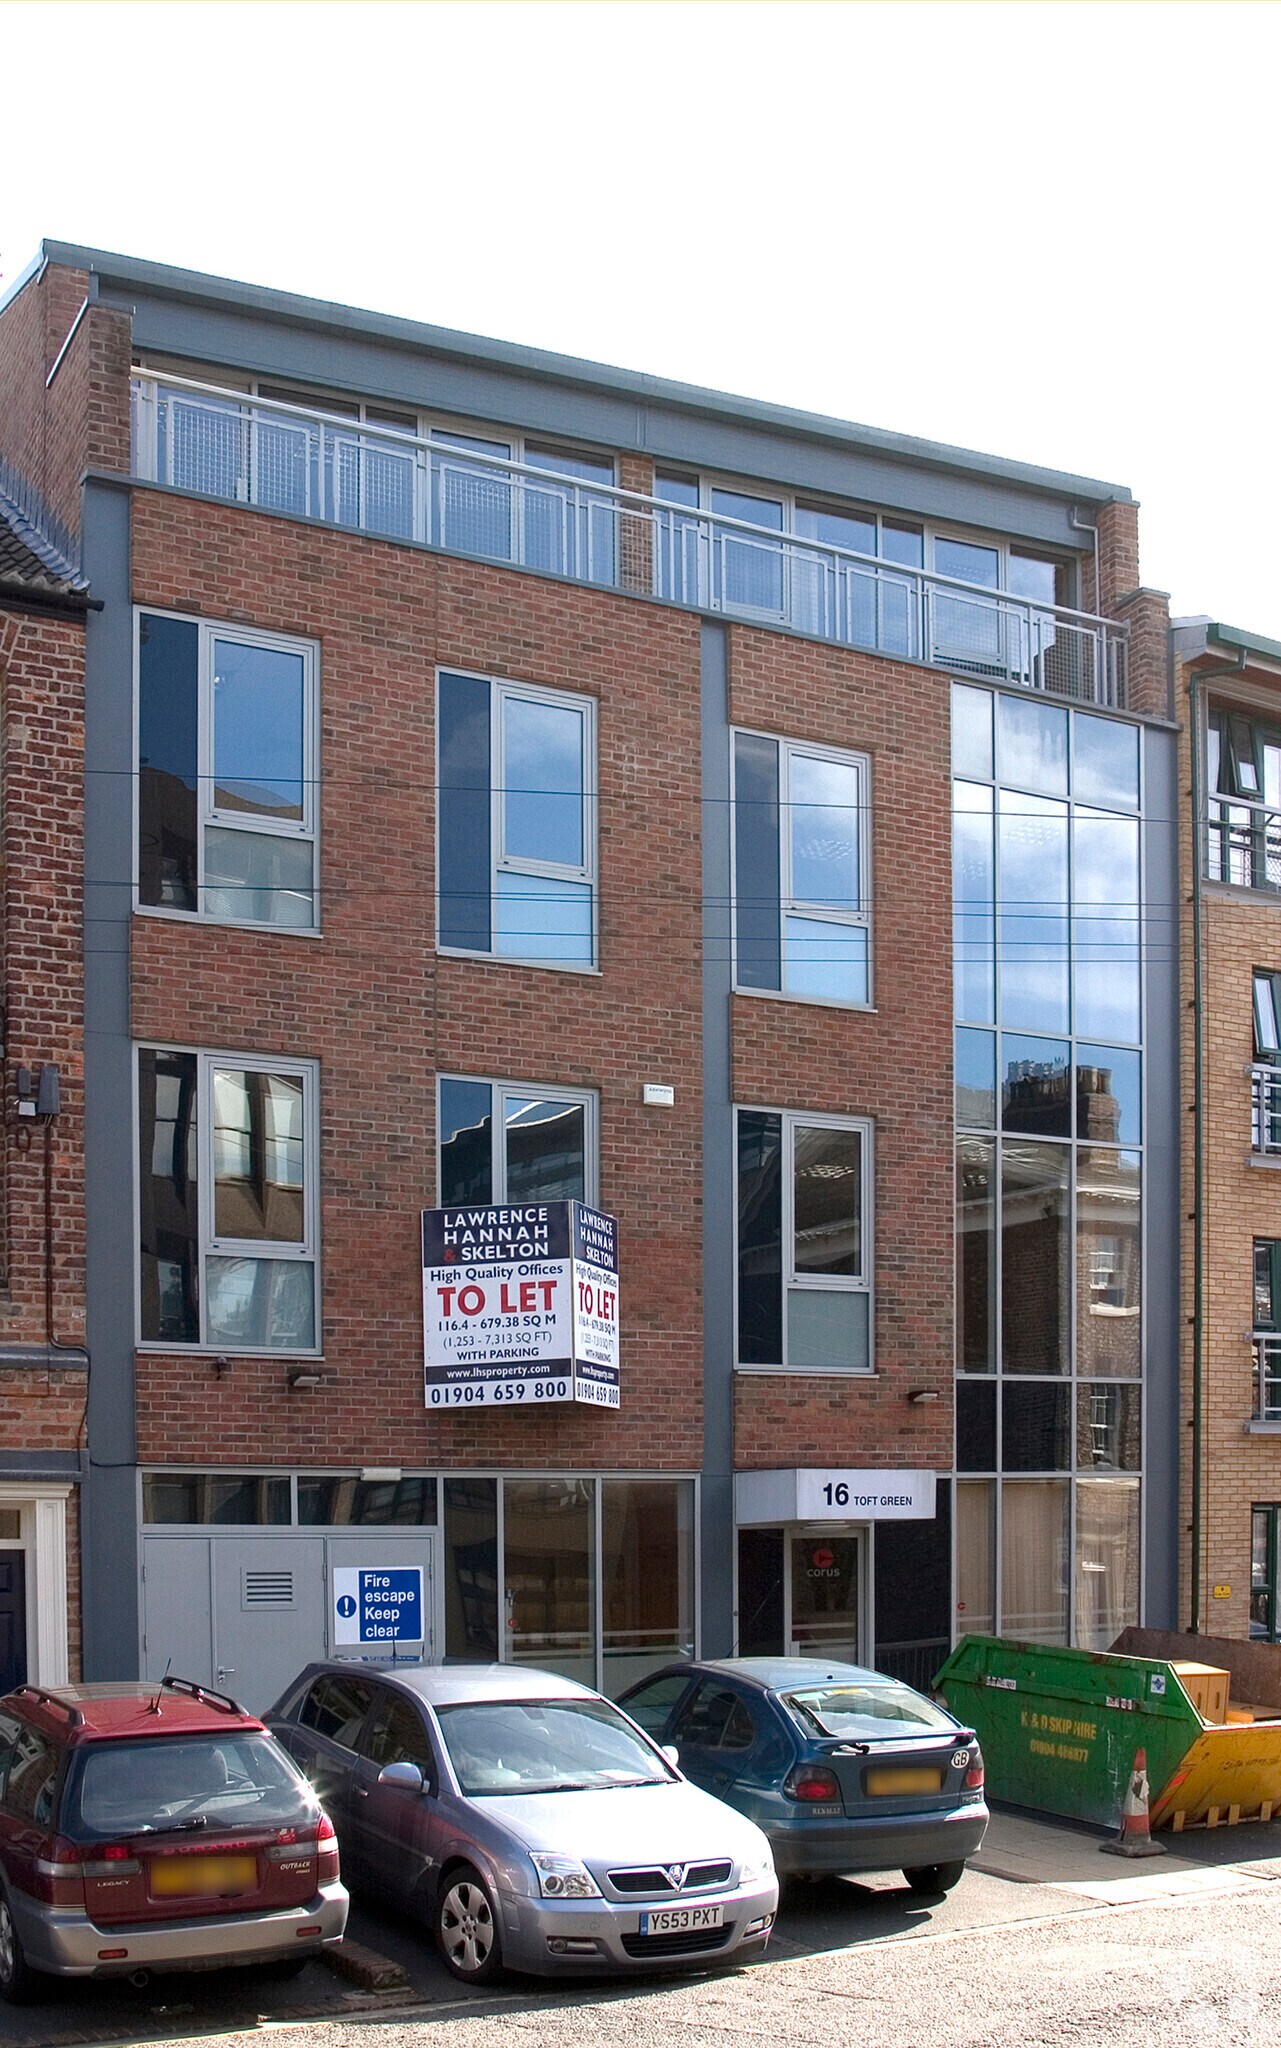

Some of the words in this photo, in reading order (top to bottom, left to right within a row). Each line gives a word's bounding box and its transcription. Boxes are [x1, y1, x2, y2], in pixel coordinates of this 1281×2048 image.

[444, 1208, 548, 1228] LAWRENCE
[580, 1208, 613, 1236] LAWRENCE
[444, 1225, 548, 1245] HANNAH
[580, 1226, 613, 1252] HANNAH
[444, 1249, 456, 1262] &
[461, 1242, 549, 1261] SKELTON
[586, 1245, 614, 1268] SKELTON
[430, 1269, 461, 1284] High
[465, 1266, 514, 1280] Quality
[518, 1264, 563, 1276] Offices
[437, 1285, 486, 1317] TO
[500, 1280, 557, 1313] LET
[579, 1281, 593, 1315] TO
[597, 1288, 616, 1321] LET
[438, 1320, 469, 1332] 116.4
[480, 1316, 519, 1329] 679.38
[523, 1315, 541, 1327] SQ
[545, 1314, 556, 1325] M
[443, 1336, 475, 1349] (1,253
[485, 1333, 513, 1346] 7,313
[515, 1332, 532, 1343] SQ
[534, 1331, 553, 1344] FT)
[457, 1350, 487, 1361] WITH
[490, 1347, 540, 1359] PARKING
[446, 1365, 550, 1379] www.lhsproperty.com
[431, 1386, 485, 1404] 01904
[494, 1384, 526, 1400] 659
[534, 1381, 567, 1398] 800
[577, 1382, 594, 1400] 01904
[596, 1386, 607, 1402] 659
[823, 1482, 849, 1506] 16
[854, 1496, 878, 1506] TOFT
[880, 1496, 912, 1506] GREEN
[364, 1574, 390, 1588] Fire
[807, 1567, 840, 1578] corus
[365, 1591, 415, 1604] escape
[365, 1607, 400, 1622] Keep
[365, 1624, 400, 1637] clear
[1049, 1717, 1072, 1734] SKIP
[1073, 1721, 1097, 1740] HIRE
[954, 1751, 967, 1766] GB
[280, 1861, 311, 1870] OUTBACK
[651, 1911, 689, 1931] YS53
[693, 1908, 720, 1926] PXT
